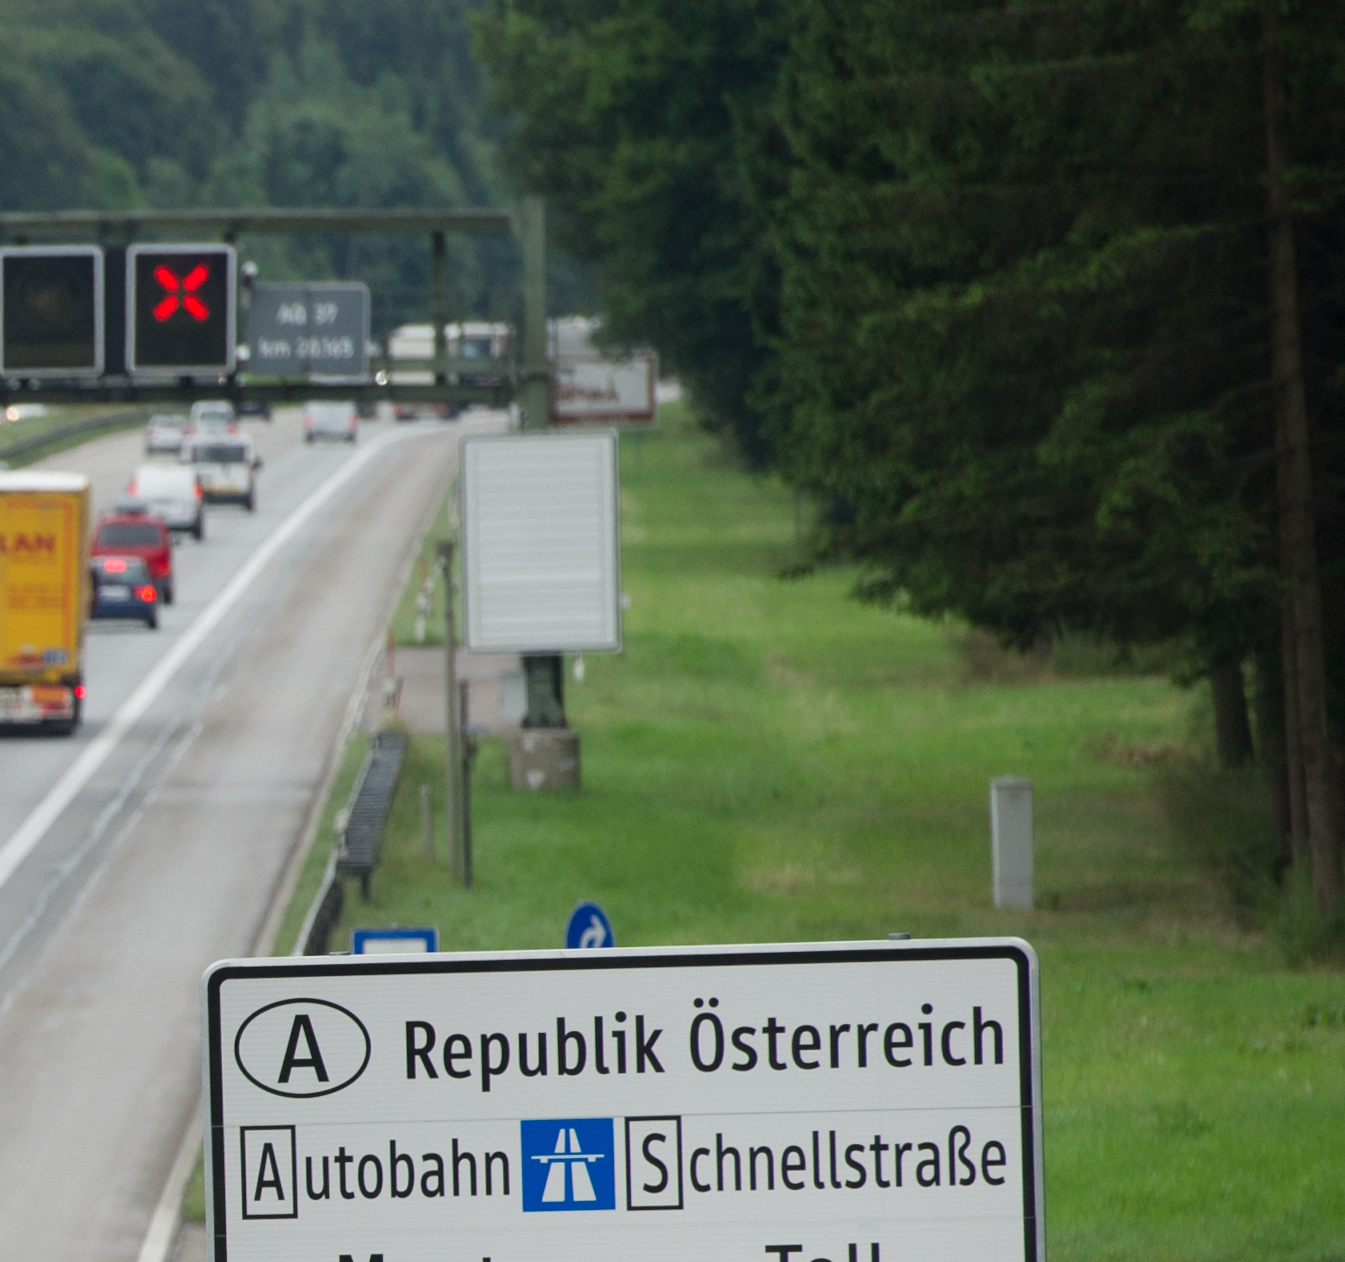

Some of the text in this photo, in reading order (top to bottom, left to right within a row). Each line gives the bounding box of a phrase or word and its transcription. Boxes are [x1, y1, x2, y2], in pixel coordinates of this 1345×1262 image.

[257, 337, 291, 359] km
[278, 998, 1003, 1093] A Republik Österreich
[254, 1126, 1006, 1201] Autobahn Schnellstraße
